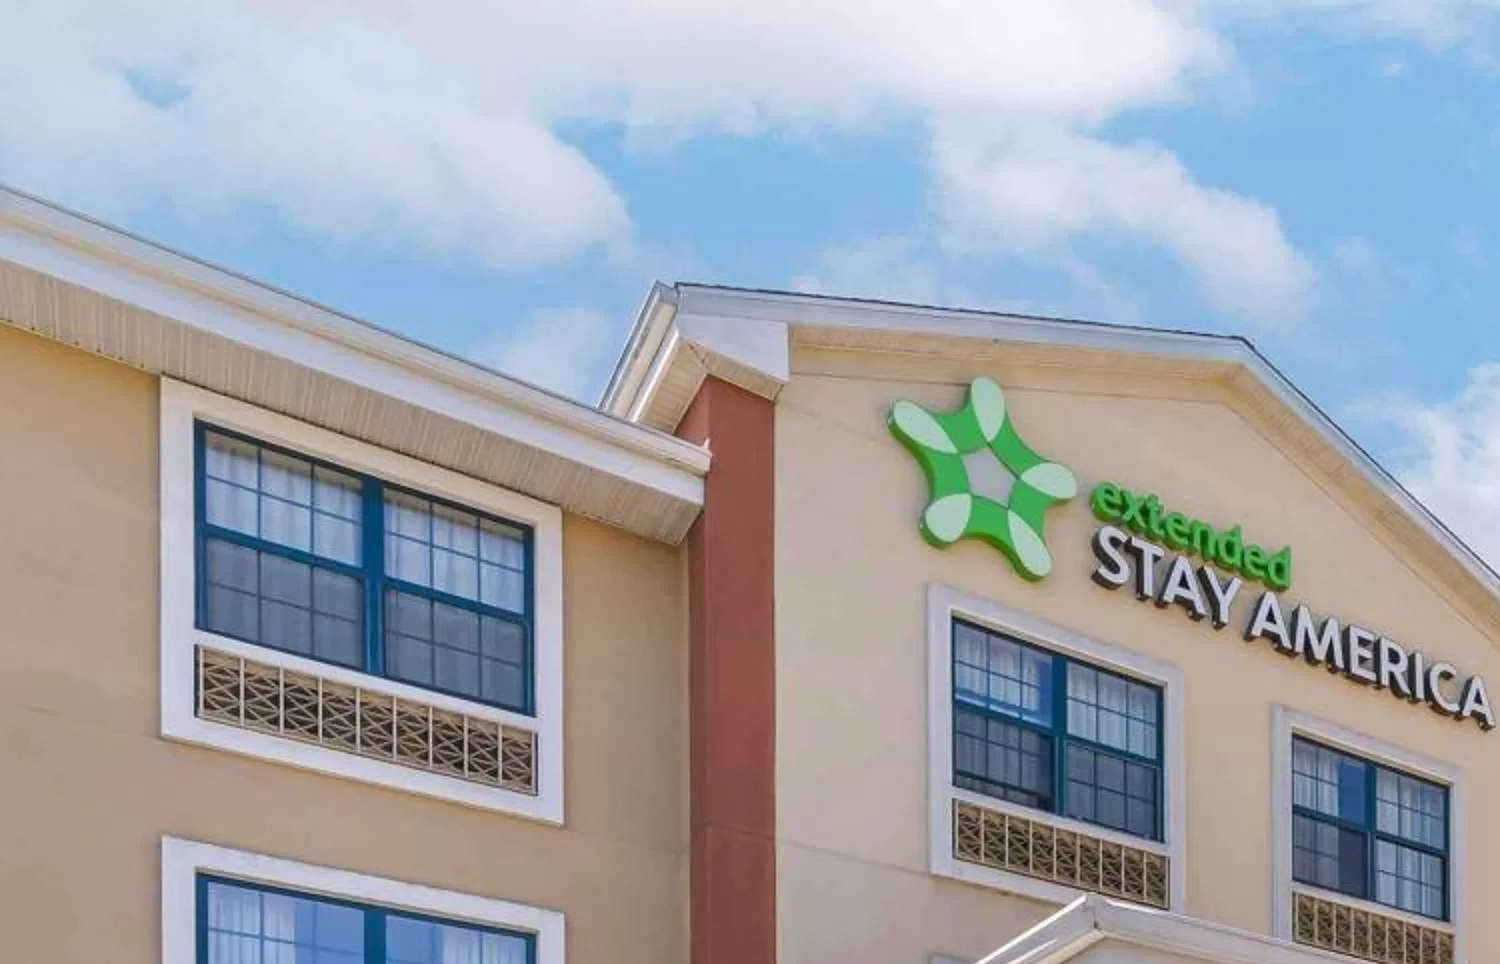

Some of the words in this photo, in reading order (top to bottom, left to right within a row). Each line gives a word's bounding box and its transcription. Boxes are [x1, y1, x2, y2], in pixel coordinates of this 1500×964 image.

[1090, 480, 1292, 592] extended
[1093, 525, 1242, 629] STAY
[1245, 591, 1496, 731] AMERICA
